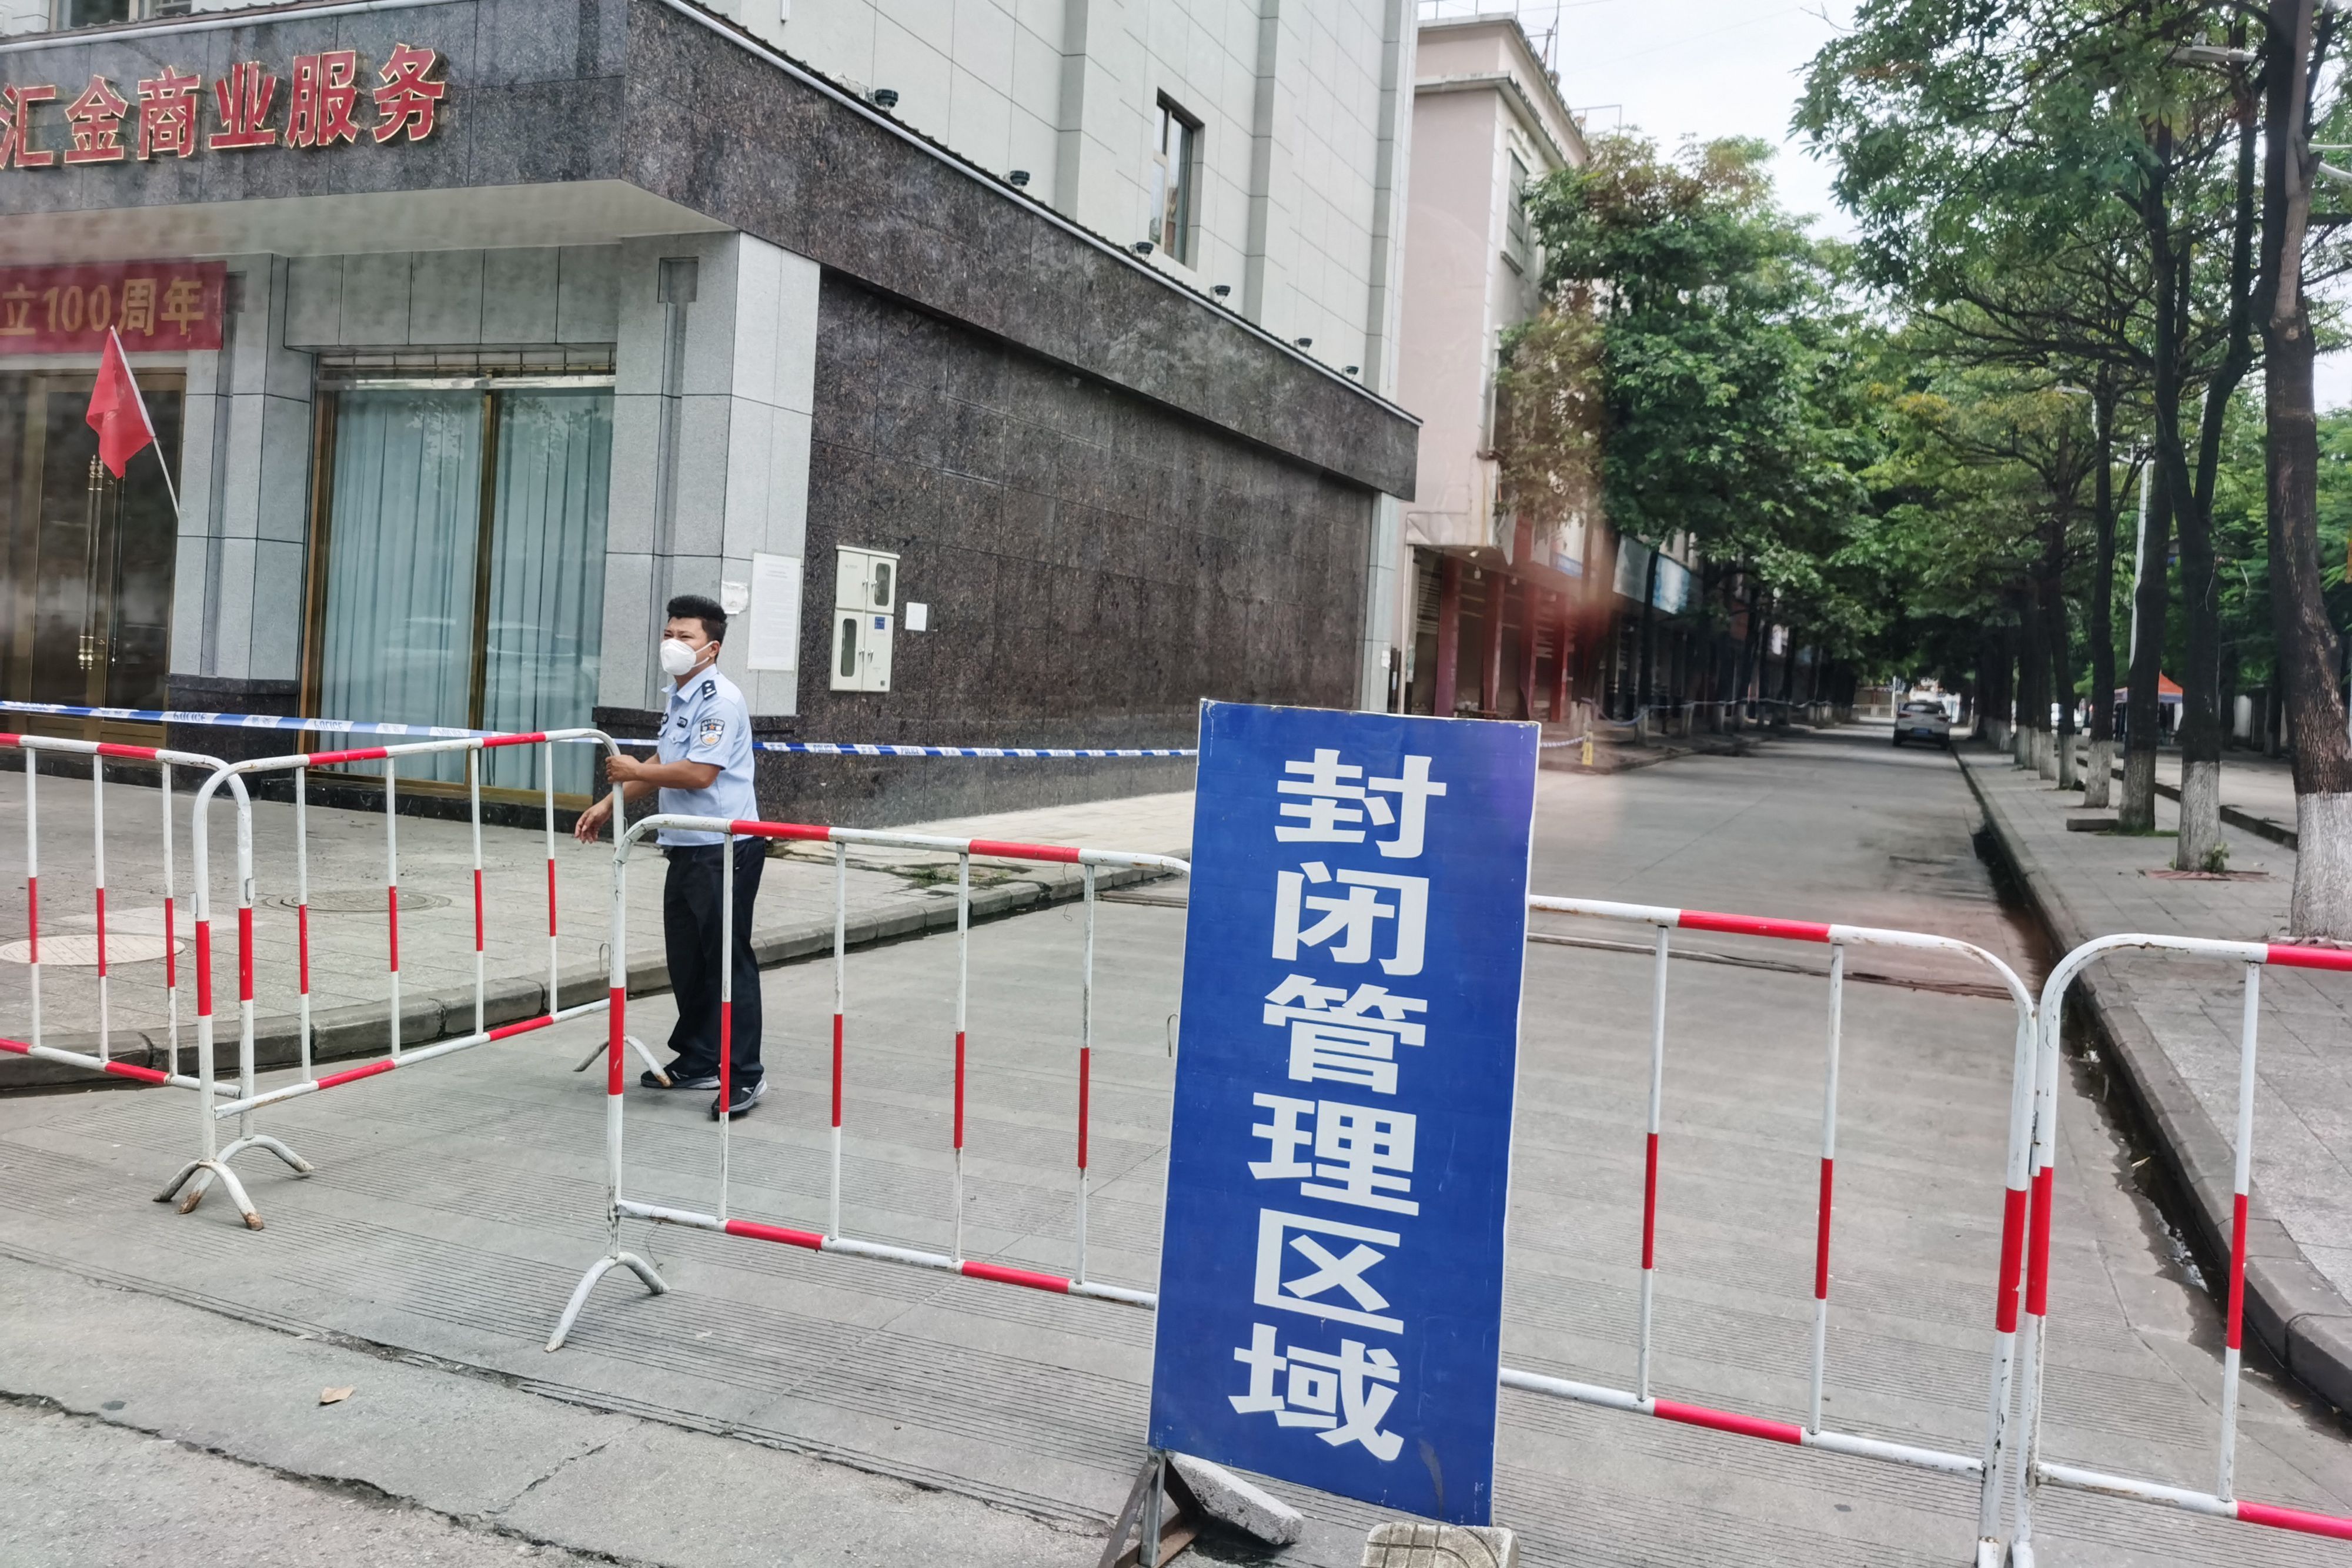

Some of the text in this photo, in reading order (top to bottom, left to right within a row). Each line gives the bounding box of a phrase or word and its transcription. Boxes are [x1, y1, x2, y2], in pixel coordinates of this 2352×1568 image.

[0, 43, 445, 169] 汇金商业服务
[0, 276, 205, 336] 立100周年
[1228, 748, 1446, 1462] 封闭管理区域
